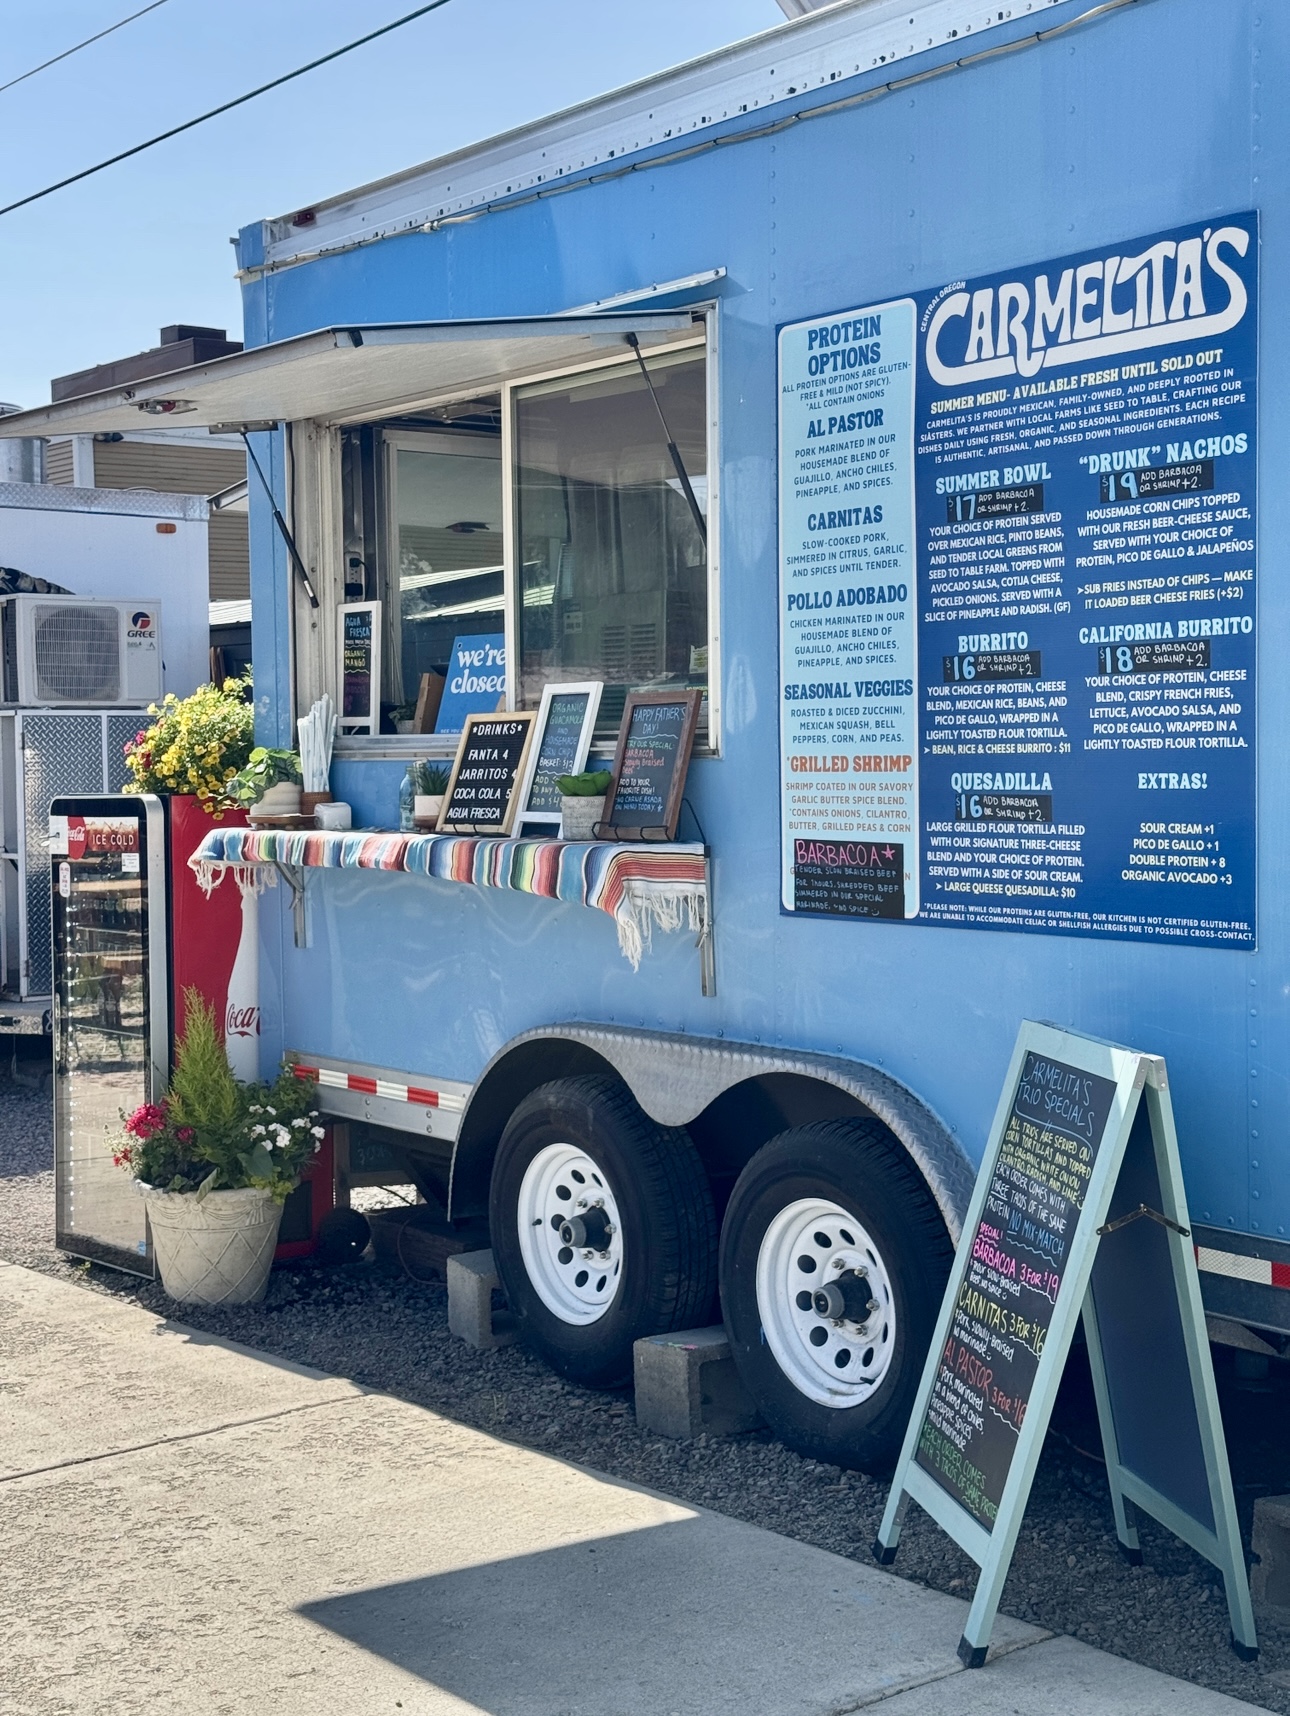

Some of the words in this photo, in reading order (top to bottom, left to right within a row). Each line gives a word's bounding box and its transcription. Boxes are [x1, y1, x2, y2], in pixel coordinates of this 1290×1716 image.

[921, 295, 940, 332] CENTRAL
[939, 281, 966, 299] OREGON
[926, 227, 1250, 386] CARMELITA'S
[808, 315, 880, 349] PROTEIN
[808, 342, 880, 375] OPTIONS
[782, 384, 794, 393] ALL
[796, 378, 826, 390] PROTEIN
[828, 370, 859, 384] OPTIONS
[861, 367, 876, 377] ARE
[878, 361, 910, 374] GLUTEN-
[930, 395, 974, 414] SUMMER
[976, 389, 1009, 405] MENU-
[1013, 376, 1077, 399] AVAILABLE
[1080, 368, 1118, 386] FRESH
[1121, 361, 1158, 379] UNTIL
[1161, 354, 1193, 372] SOLD
[1196, 349, 1222, 365] OUT
[807, 419, 825, 438] AL
[828, 408, 883, 434] PASTOR
[795, 447, 815, 458] PORK
[818, 439, 864, 453] MARINATED
[867, 436, 875, 446] IN
[878, 433, 895, 444] OUR
[1166, 433, 1247, 462] NACHOS
[936, 470, 999, 493] SUMMER
[1003, 462, 1051, 484] BOWL
[1139, 482, 1151, 492] OR
[1152, 478, 1180, 490] SHRIMP
[1140, 471, 1156, 482] ADD
[1158, 464, 1201, 479] BARBACOA
[808, 505, 882, 530] CARNITAS
[1086, 504, 1141, 520] HOUSEMADE
[1142, 501, 1170, 513] CORN
[1171, 497, 1200, 510] CHIPS
[1202, 492, 1240, 506] TOPPED
[929, 525, 951, 536] YOUR
[952, 521, 981, 534] CHOICE
[982, 520, 993, 530] OF
[995, 516, 1028, 528] PROTEIN
[1030, 512, 1061, 524] SERVED
[802, 535, 860, 549] SLOW-COOKED
[863, 532, 888, 542] PORK,
[787, 591, 832, 610] POLLO
[837, 584, 907, 606] ADOBADO
[127, 630, 155, 638] GREE
[345, 617, 361, 627] AGUA
[350, 626, 370, 638] FRESCA
[1079, 622, 1172, 643] CALIFORNIA
[1178, 616, 1252, 637] BURRITO
[958, 632, 1027, 652] BURRITO
[457, 643, 506, 668] we're
[784, 682, 850, 700] SEASONAL
[855, 679, 912, 697] VEGGIES
[552, 702, 584, 713] ORGANIC
[633, 708, 655, 721] HAPPY
[790, 708, 825, 717] ROASTED
[827, 707, 833, 716] &
[835, 707, 859, 716] DICED
[862, 705, 904, 715] ZUCCHINI,
[477, 723, 516, 735] DRINKS
[468, 748, 498, 760] FANTA
[502, 749, 508, 759] 4
[853, 755, 911, 772] SHRIMP
[459, 767, 507, 780] JARRITOS
[951, 772, 1051, 791] QUESADILLA
[1138, 772, 1206, 789] EXTRAS!
[453, 787, 475, 799] COCA
[478, 787, 500, 799] COLA
[786, 782, 813, 790] SHRIMP
[815, 782, 846, 790] COATED
[848, 782, 856, 790] IN
[858, 782, 876, 791] OUR
[878, 782, 912, 791] SAVORY
[446, 807, 468, 818] AGUA
[469, 807, 500, 818] FRESCA
[92, 834, 107, 845] ICE
[110, 834, 134, 845] COLD
[926, 821, 952, 831] LARGE
[954, 822, 987, 832] GRILLED
[988, 823, 1015, 833] FLOUR
[1017, 823, 1056, 834] TORTILLA
[1057, 824, 1085, 835] FILLED
[1140, 822, 1165, 833] SOUR
[1167, 823, 1202, 834] CREAM
[1204, 824, 1214, 834] +1
[796, 840, 882, 867] BARBACOA
[1121, 869, 1165, 881] ORGANIC
[1167, 871, 1217, 883] AVOCADO
[1219, 873, 1232, 884] +3
[1023, 1056, 1092, 1106] CARMELITA'S
[1018, 1082, 1041, 1105] TRIO
[1045, 1091, 1094, 1136] SPECIALS
[1010, 1116, 1020, 1130] ALL
[1022, 1122, 1039, 1140] TRIOS
[1040, 1130, 1053, 1143] ARE
[1054, 1135, 1077, 1154] SERVED
[1079, 1146, 1090, 1161] ON
[1005, 1131, 1019, 1143] CORN
[1021, 1135, 1053, 1160] TORTILLAS
[1054, 1152, 1067, 1166] AND
[1069, 1158, 1091, 1179] TOPPED
[995, 1162, 1010, 1179] EACH
[1010, 1169, 1027, 1190] ORDER
[1029, 1180, 1047, 1203] COMES
[1050, 1192, 1066, 1213] WITH
[986, 1196, 1010, 1220] PROTEIN
[1009, 1210, 1021, 1230] NO
[1021, 1219, 1064, 1259] MIX-MATCH
[973, 1238, 1016, 1278] BARBACOA
[1020, 1264, 1027, 1280] 3
[1026, 1268, 1042, 1287] FOR
[959, 1281, 1008, 1333] CARNITAS
[1010, 1313, 1016, 1331] 3
[1015, 1316, 1030, 1338] FOR
[944, 1338, 956, 1366] AL
[955, 1346, 992, 1403] PASTOR
